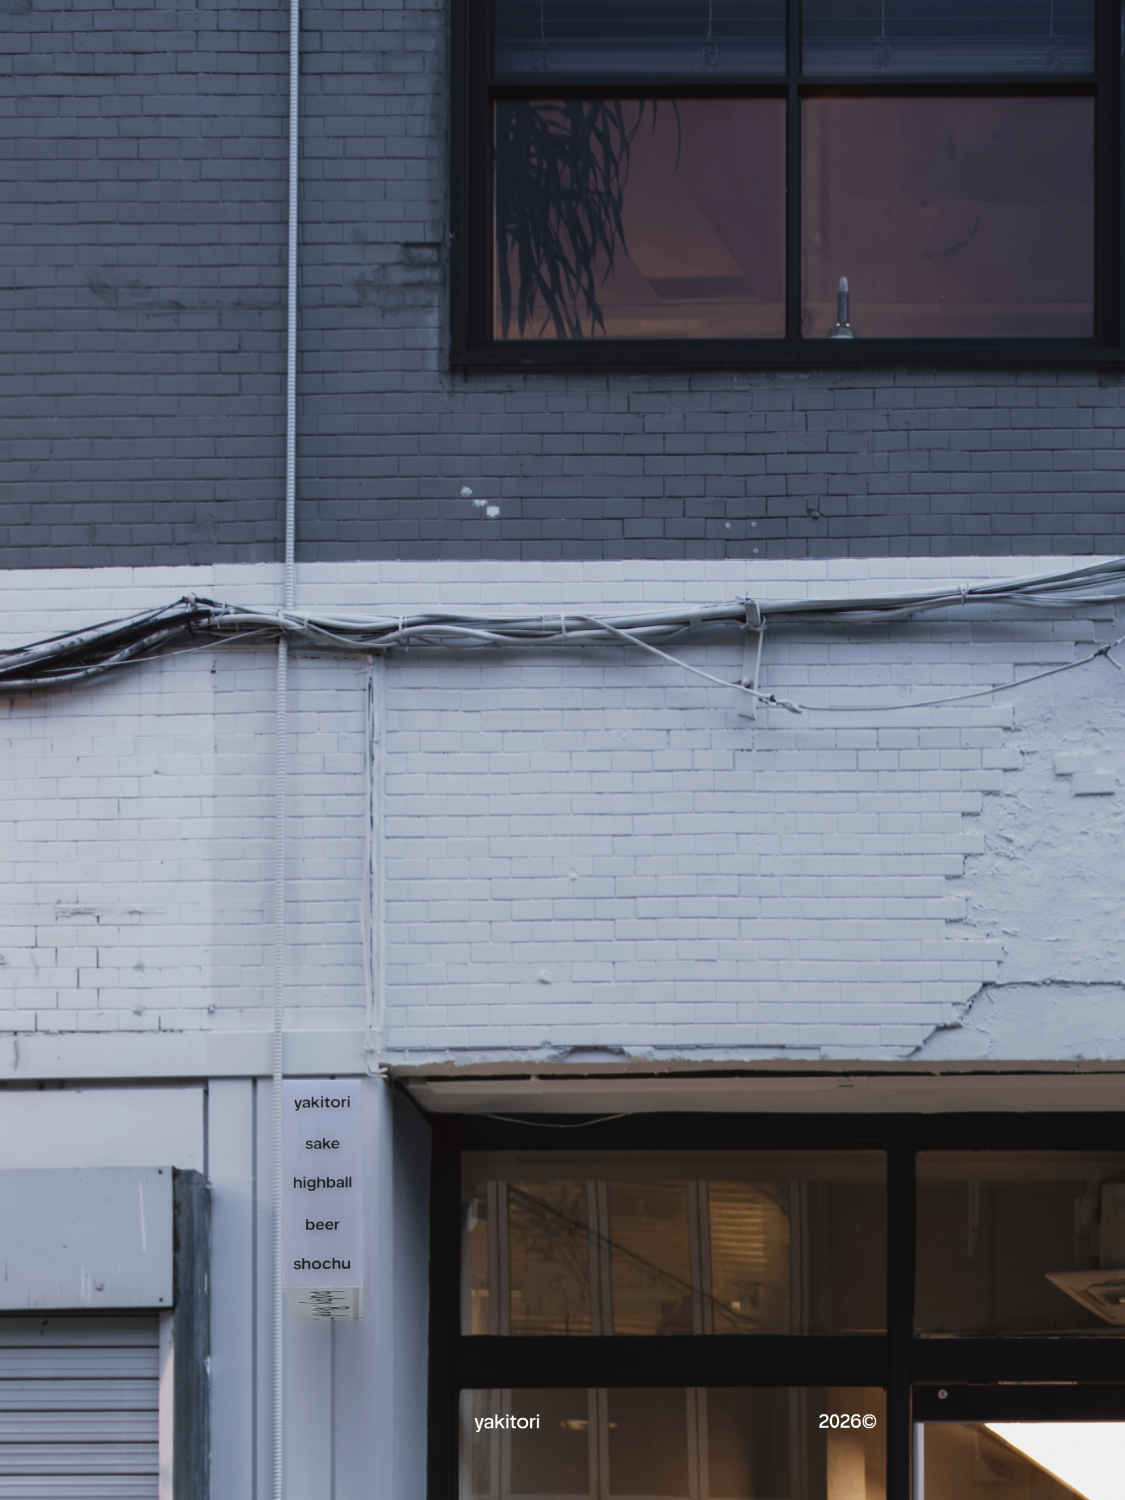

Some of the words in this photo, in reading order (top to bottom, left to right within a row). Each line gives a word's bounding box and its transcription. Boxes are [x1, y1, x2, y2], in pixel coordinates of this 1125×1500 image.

[293, 1095, 351, 1112] yakitori
[305, 1137, 341, 1150] sake
[293, 1175, 352, 1192] highball
[305, 1218, 341, 1231] beer
[293, 1257, 351, 1270] shochu
[474, 1413, 541, 1433] yakitori
